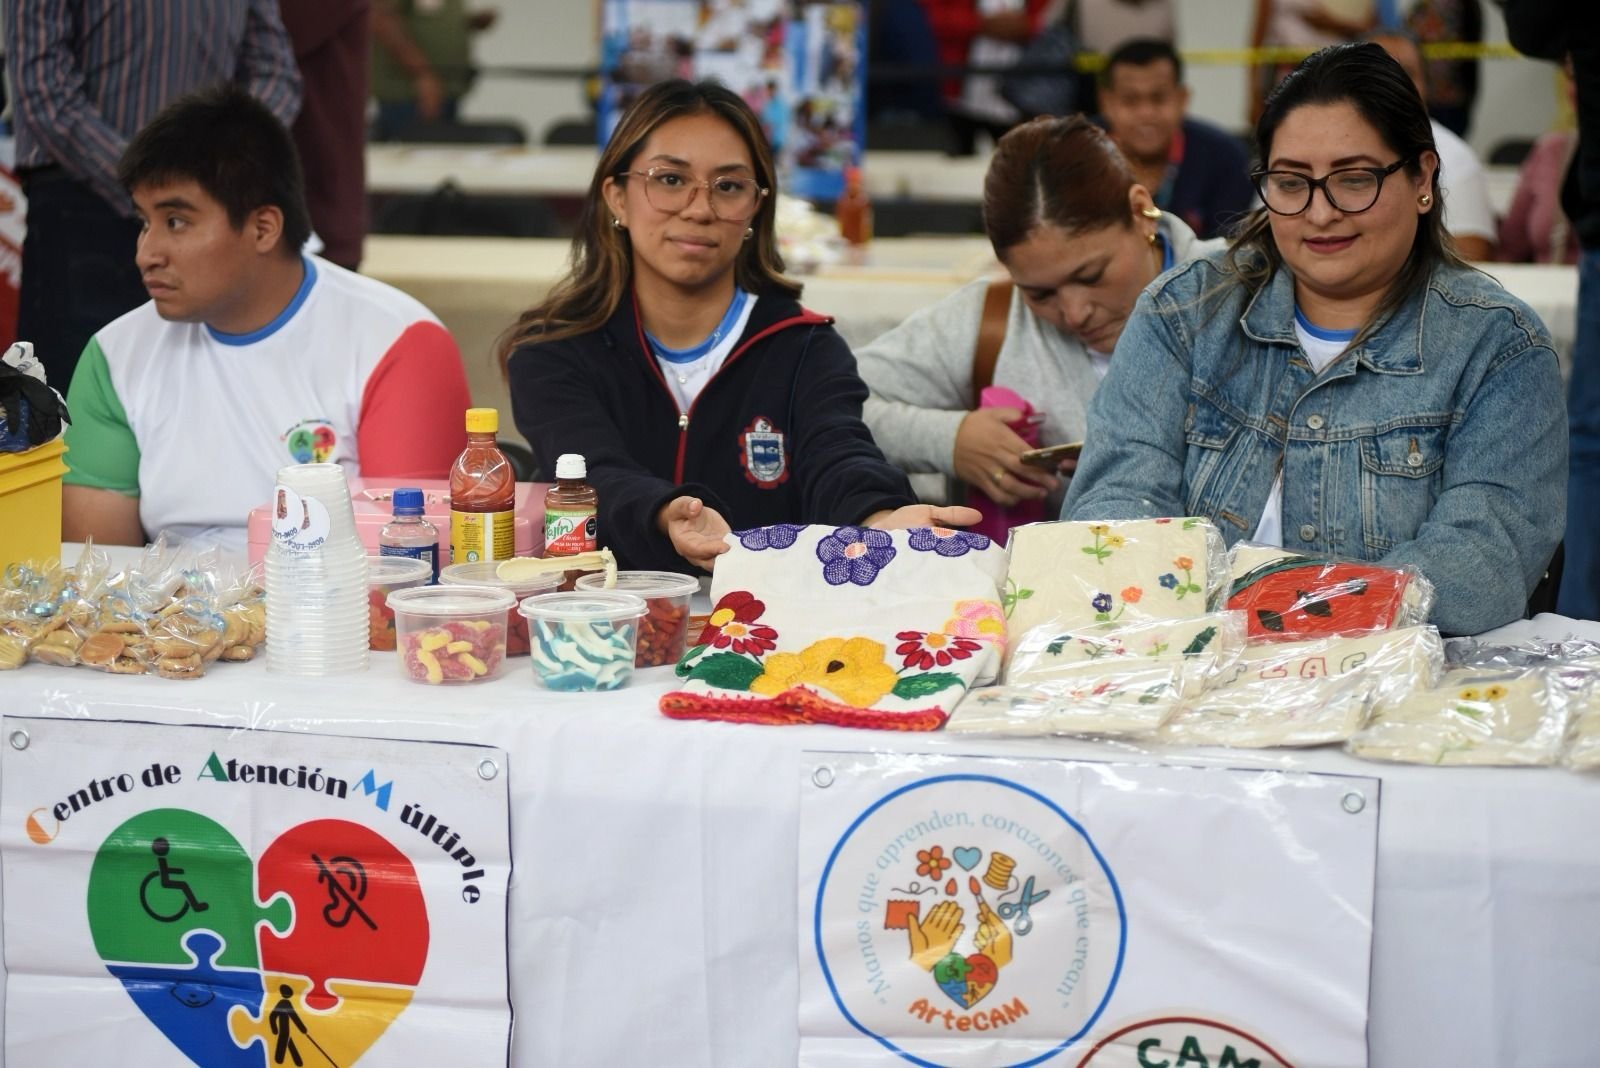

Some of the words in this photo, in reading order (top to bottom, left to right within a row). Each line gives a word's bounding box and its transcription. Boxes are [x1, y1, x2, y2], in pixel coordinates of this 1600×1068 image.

[25, 773, 134, 845] Centro
[141, 763, 182, 788] de
[197, 750, 348, 799] Atención
[858, 872, 880, 913] que
[876, 810, 976, 871] aprenden,
[981, 812, 1079, 885] corazones
[1067, 888, 1090, 929] que
[908, 996, 1029, 1031] ArteCAM
[1136, 1035, 1262, 1068] CAM
